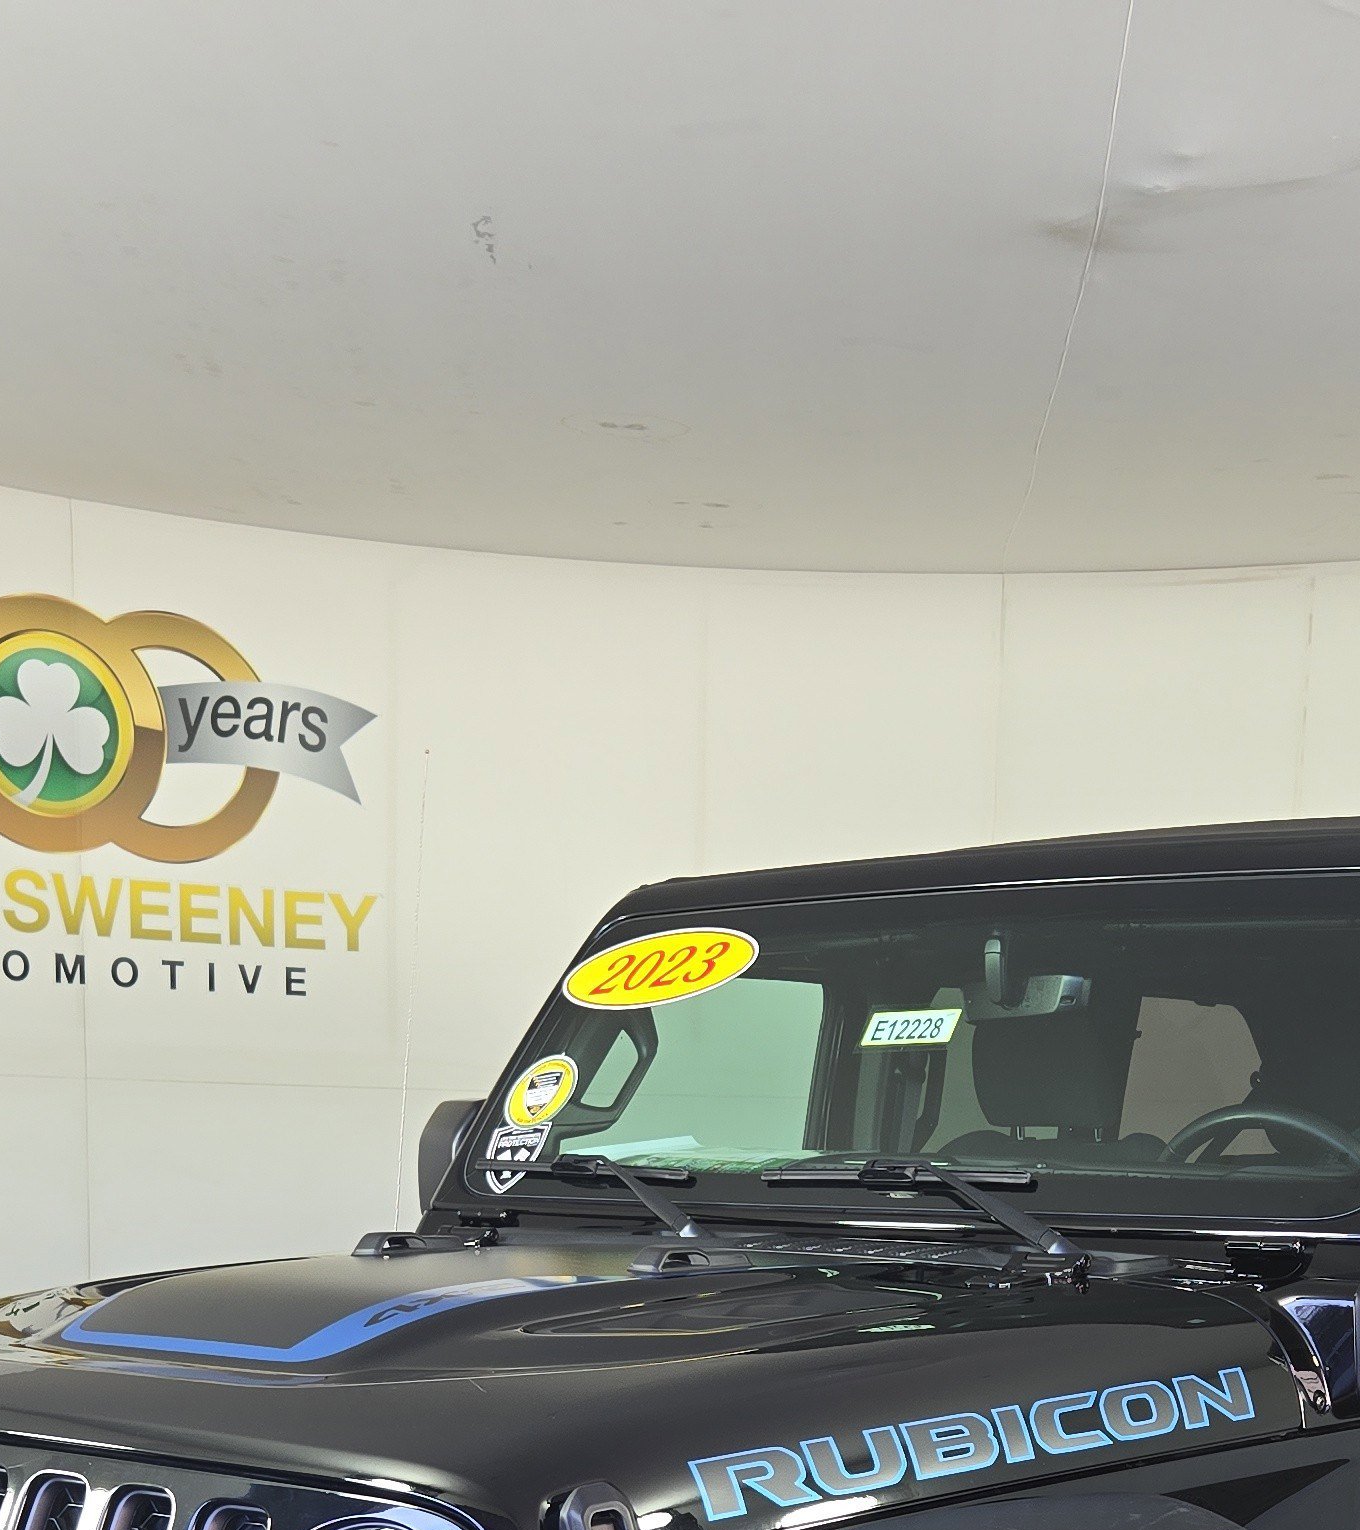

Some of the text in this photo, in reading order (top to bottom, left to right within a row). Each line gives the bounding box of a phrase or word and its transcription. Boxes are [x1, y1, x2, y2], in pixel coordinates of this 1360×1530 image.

[177, 694, 329, 753] years
[3, 869, 378, 952] SWEENEY
[589, 942, 730, 995] 2023
[871, 1018, 944, 1041] E12228
[687, 1366, 1256, 1522] RUBICON
